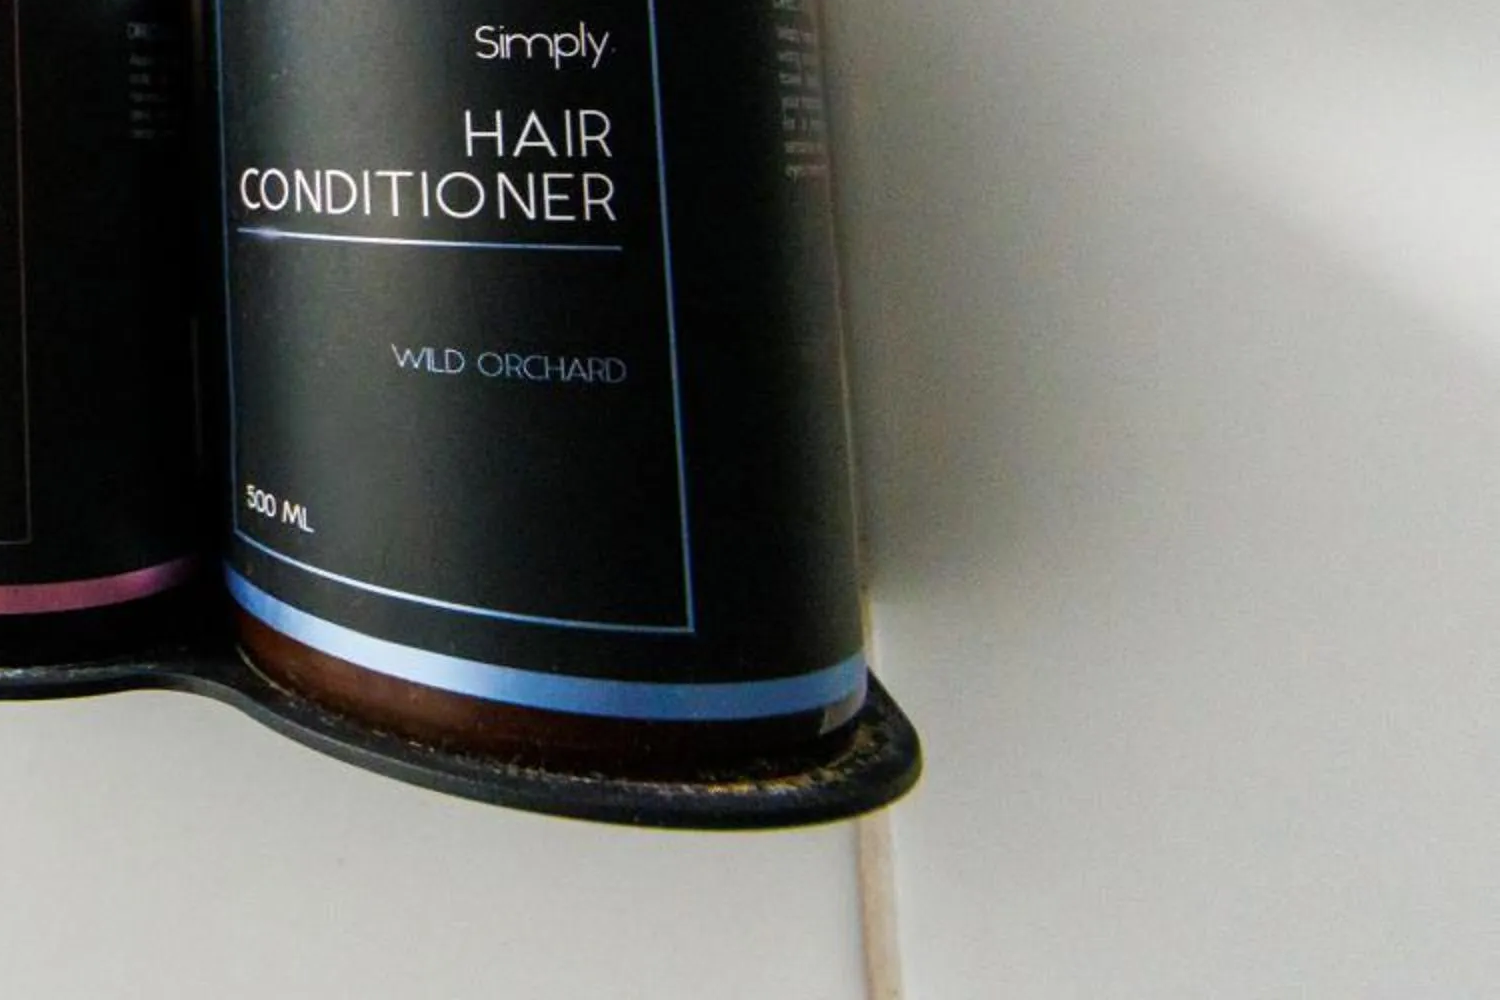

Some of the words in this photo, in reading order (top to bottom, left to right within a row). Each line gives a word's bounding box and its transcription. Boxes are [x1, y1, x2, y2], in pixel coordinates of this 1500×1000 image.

[475, 21, 610, 69] Simply
[464, 109, 614, 158] HAIR
[239, 166, 617, 223] CONDITIONER
[391, 343, 466, 375] WILD
[476, 352, 628, 385] ORCHARD
[245, 484, 277, 519] 500
[281, 500, 315, 535] ML
